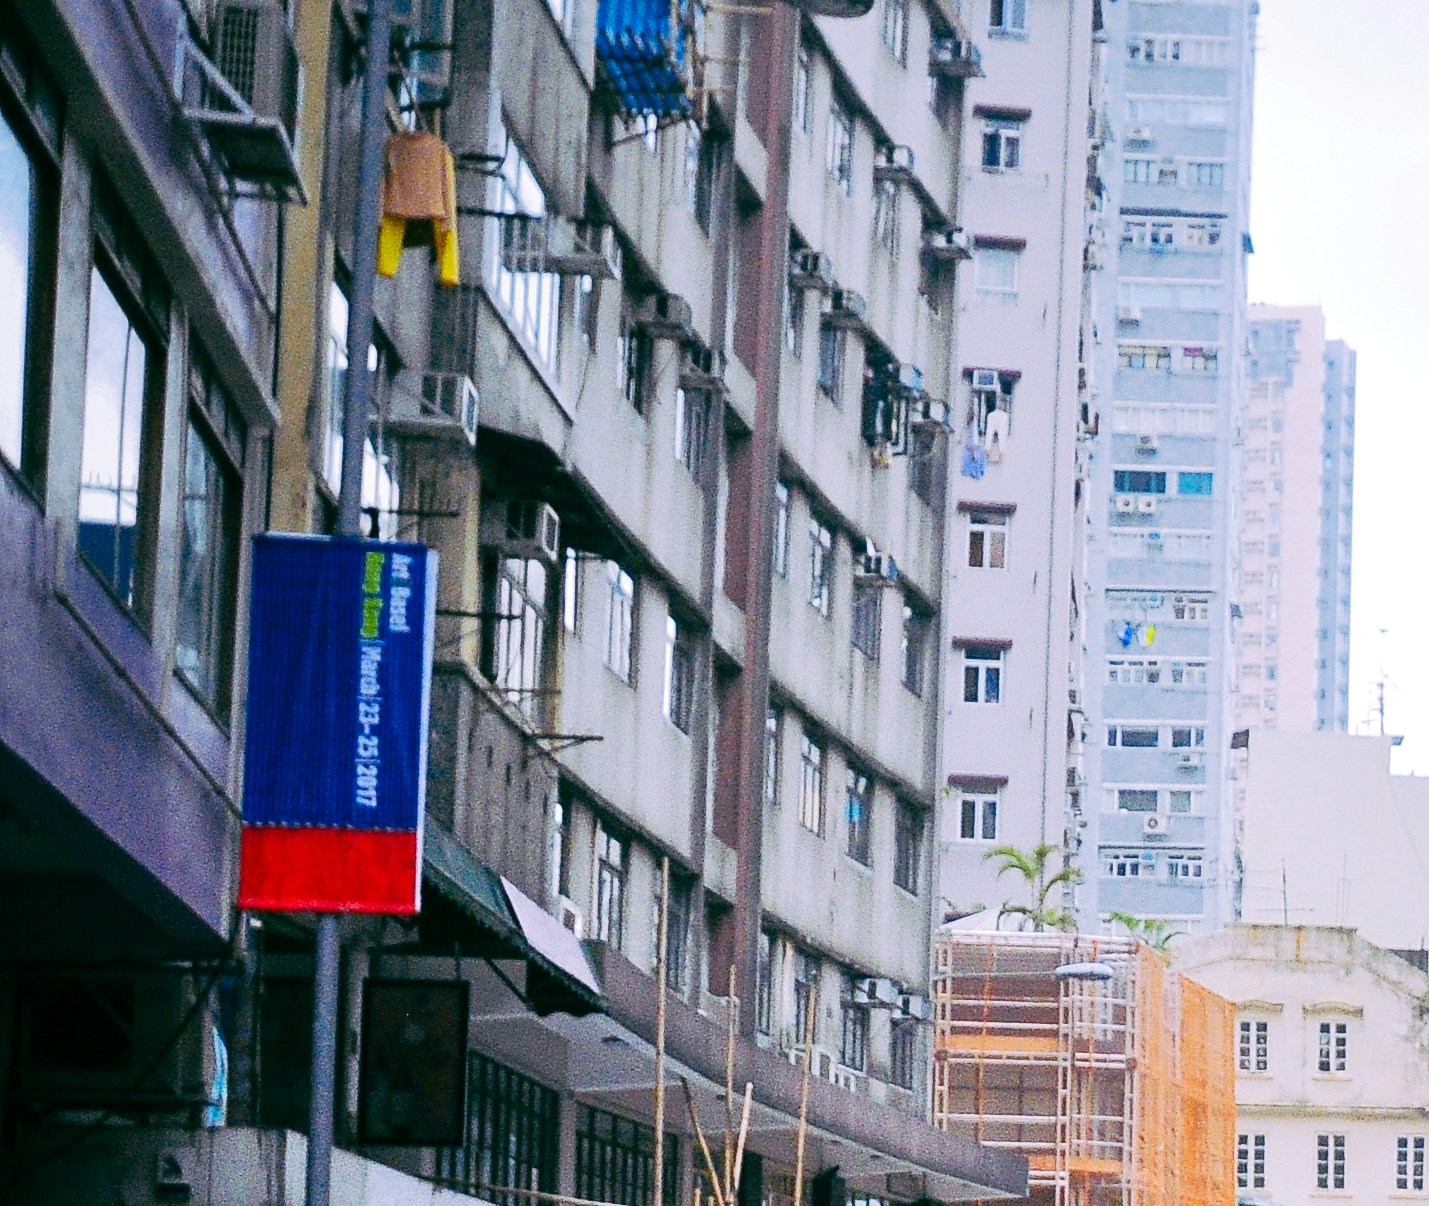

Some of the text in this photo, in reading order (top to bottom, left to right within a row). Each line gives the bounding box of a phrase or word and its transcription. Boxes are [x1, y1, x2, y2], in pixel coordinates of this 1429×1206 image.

[389, 552, 412, 633] Art Basel
[355, 552, 386, 807] Hong Kong March 23-25 2017
